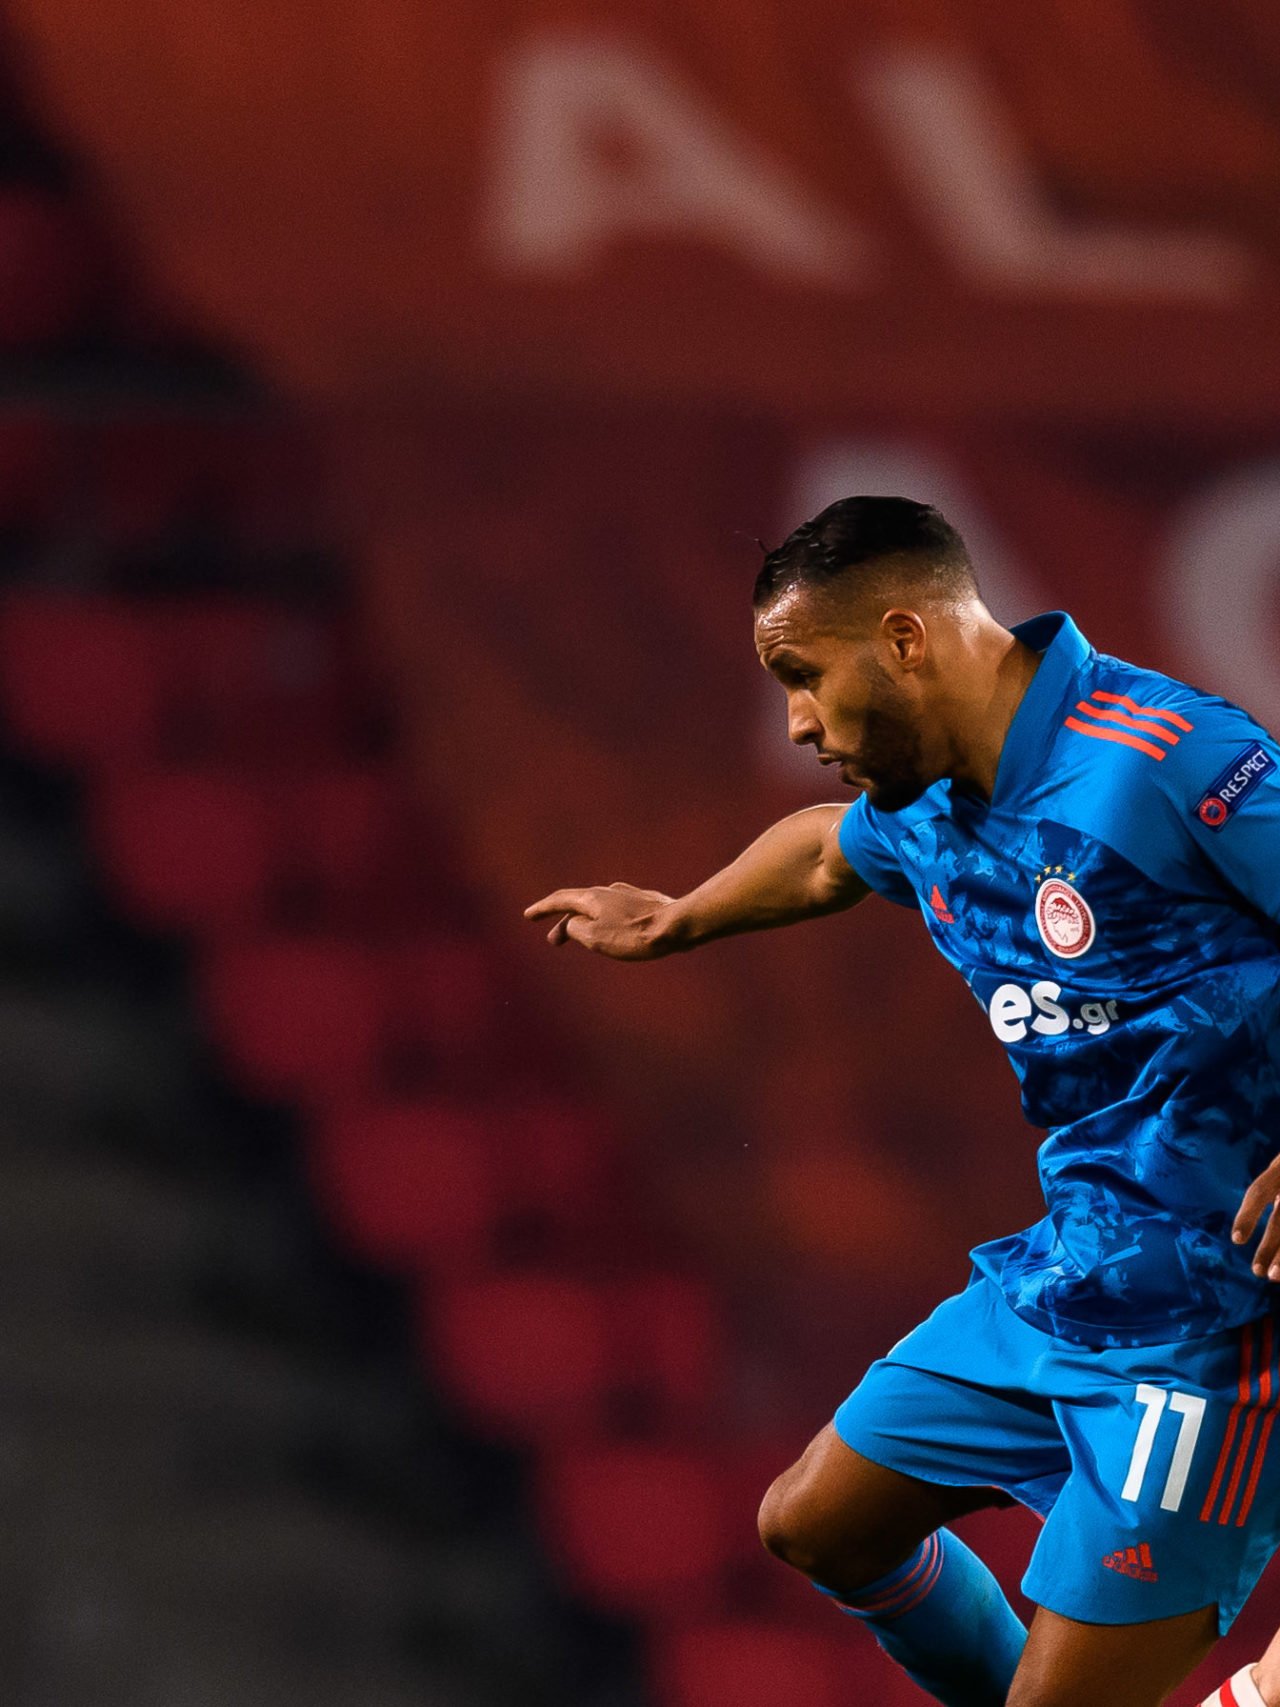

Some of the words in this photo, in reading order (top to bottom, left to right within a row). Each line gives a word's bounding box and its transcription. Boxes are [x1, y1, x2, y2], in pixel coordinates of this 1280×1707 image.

[488, 38, 1250, 295] AL
[1219, 750, 1269, 803] RESPECT
[1121, 1383, 1207, 1512] 11
